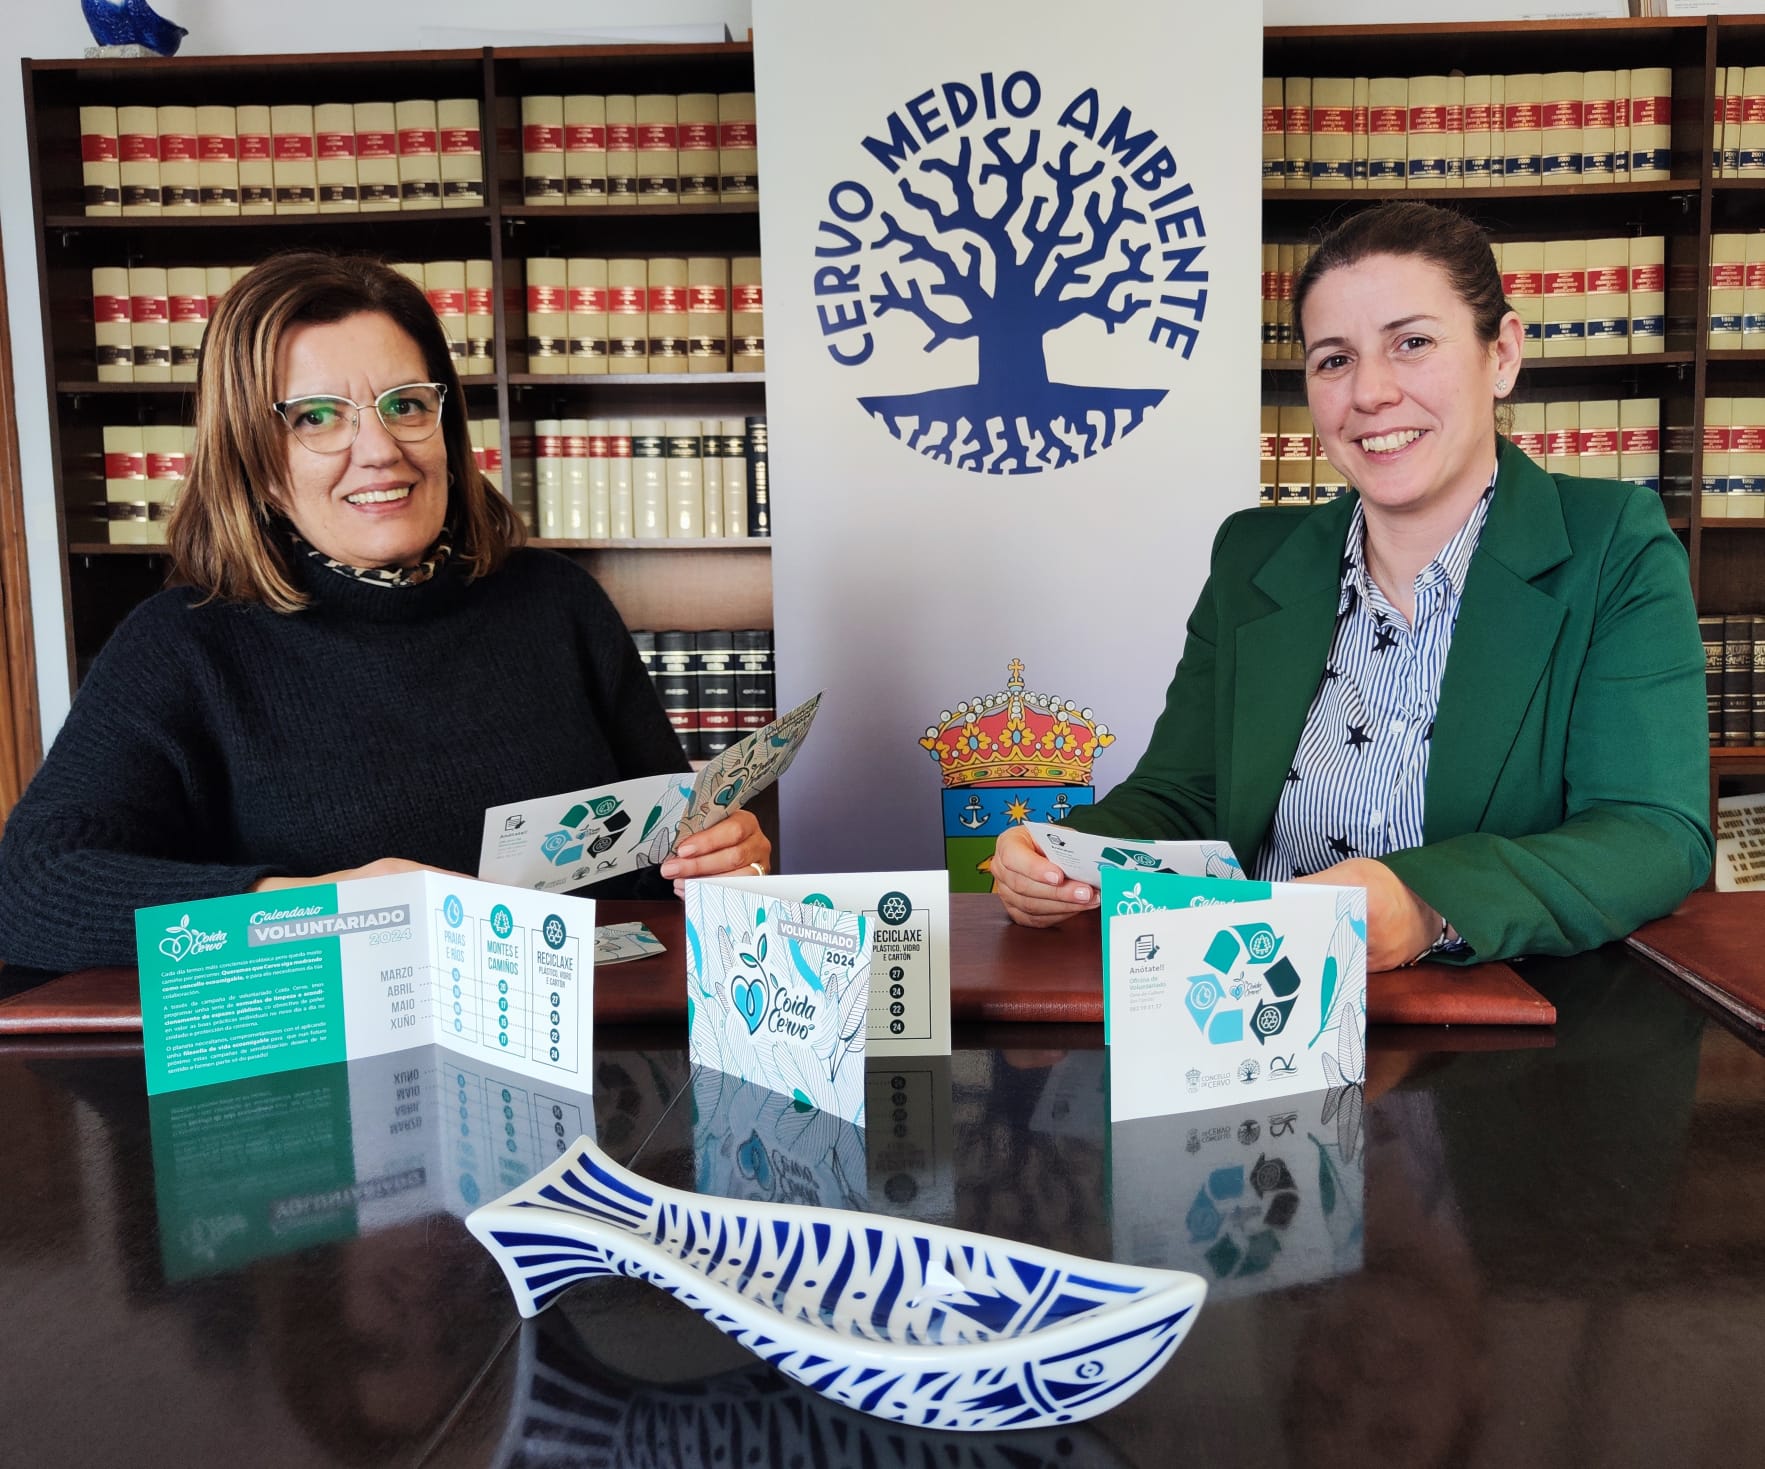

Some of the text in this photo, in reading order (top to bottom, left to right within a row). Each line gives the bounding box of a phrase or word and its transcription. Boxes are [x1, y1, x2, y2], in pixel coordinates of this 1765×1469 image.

[814, 70, 1208, 366] CERVO MEDIO AMBIENTE
[250, 906, 324, 925] Calendario
[255, 909, 404, 942] VOLUNTARIADO
[195, 930, 228, 944] Coida
[369, 928, 412, 946] 2024
[444, 930, 466, 946] PRAIAS
[780, 923, 854, 948] VOLUNTARIADO
[191, 940, 228, 956] Cervo
[446, 946, 464, 962] E RÍOS
[487, 940, 519, 958] MONTES E
[873, 944, 902, 953] PLÁSTICO,
[537, 951, 573, 971] RECICLAXE
[826, 952, 856, 968] 2024
[888, 953, 911, 961] CARTÓN
[380, 966, 413, 982] MARZO
[488, 957, 519, 976] CAMIÑOS
[388, 983, 415, 997] ABRIL
[392, 999, 415, 1013] MAIO
[774, 987, 816, 1021] Coida
[390, 1014, 416, 1030] XUÑO
[768, 1008, 809, 1040] Cervo
[1201, 1073, 1231, 1081] CONCELLO
[1208, 1079, 1231, 1088] CERVO
